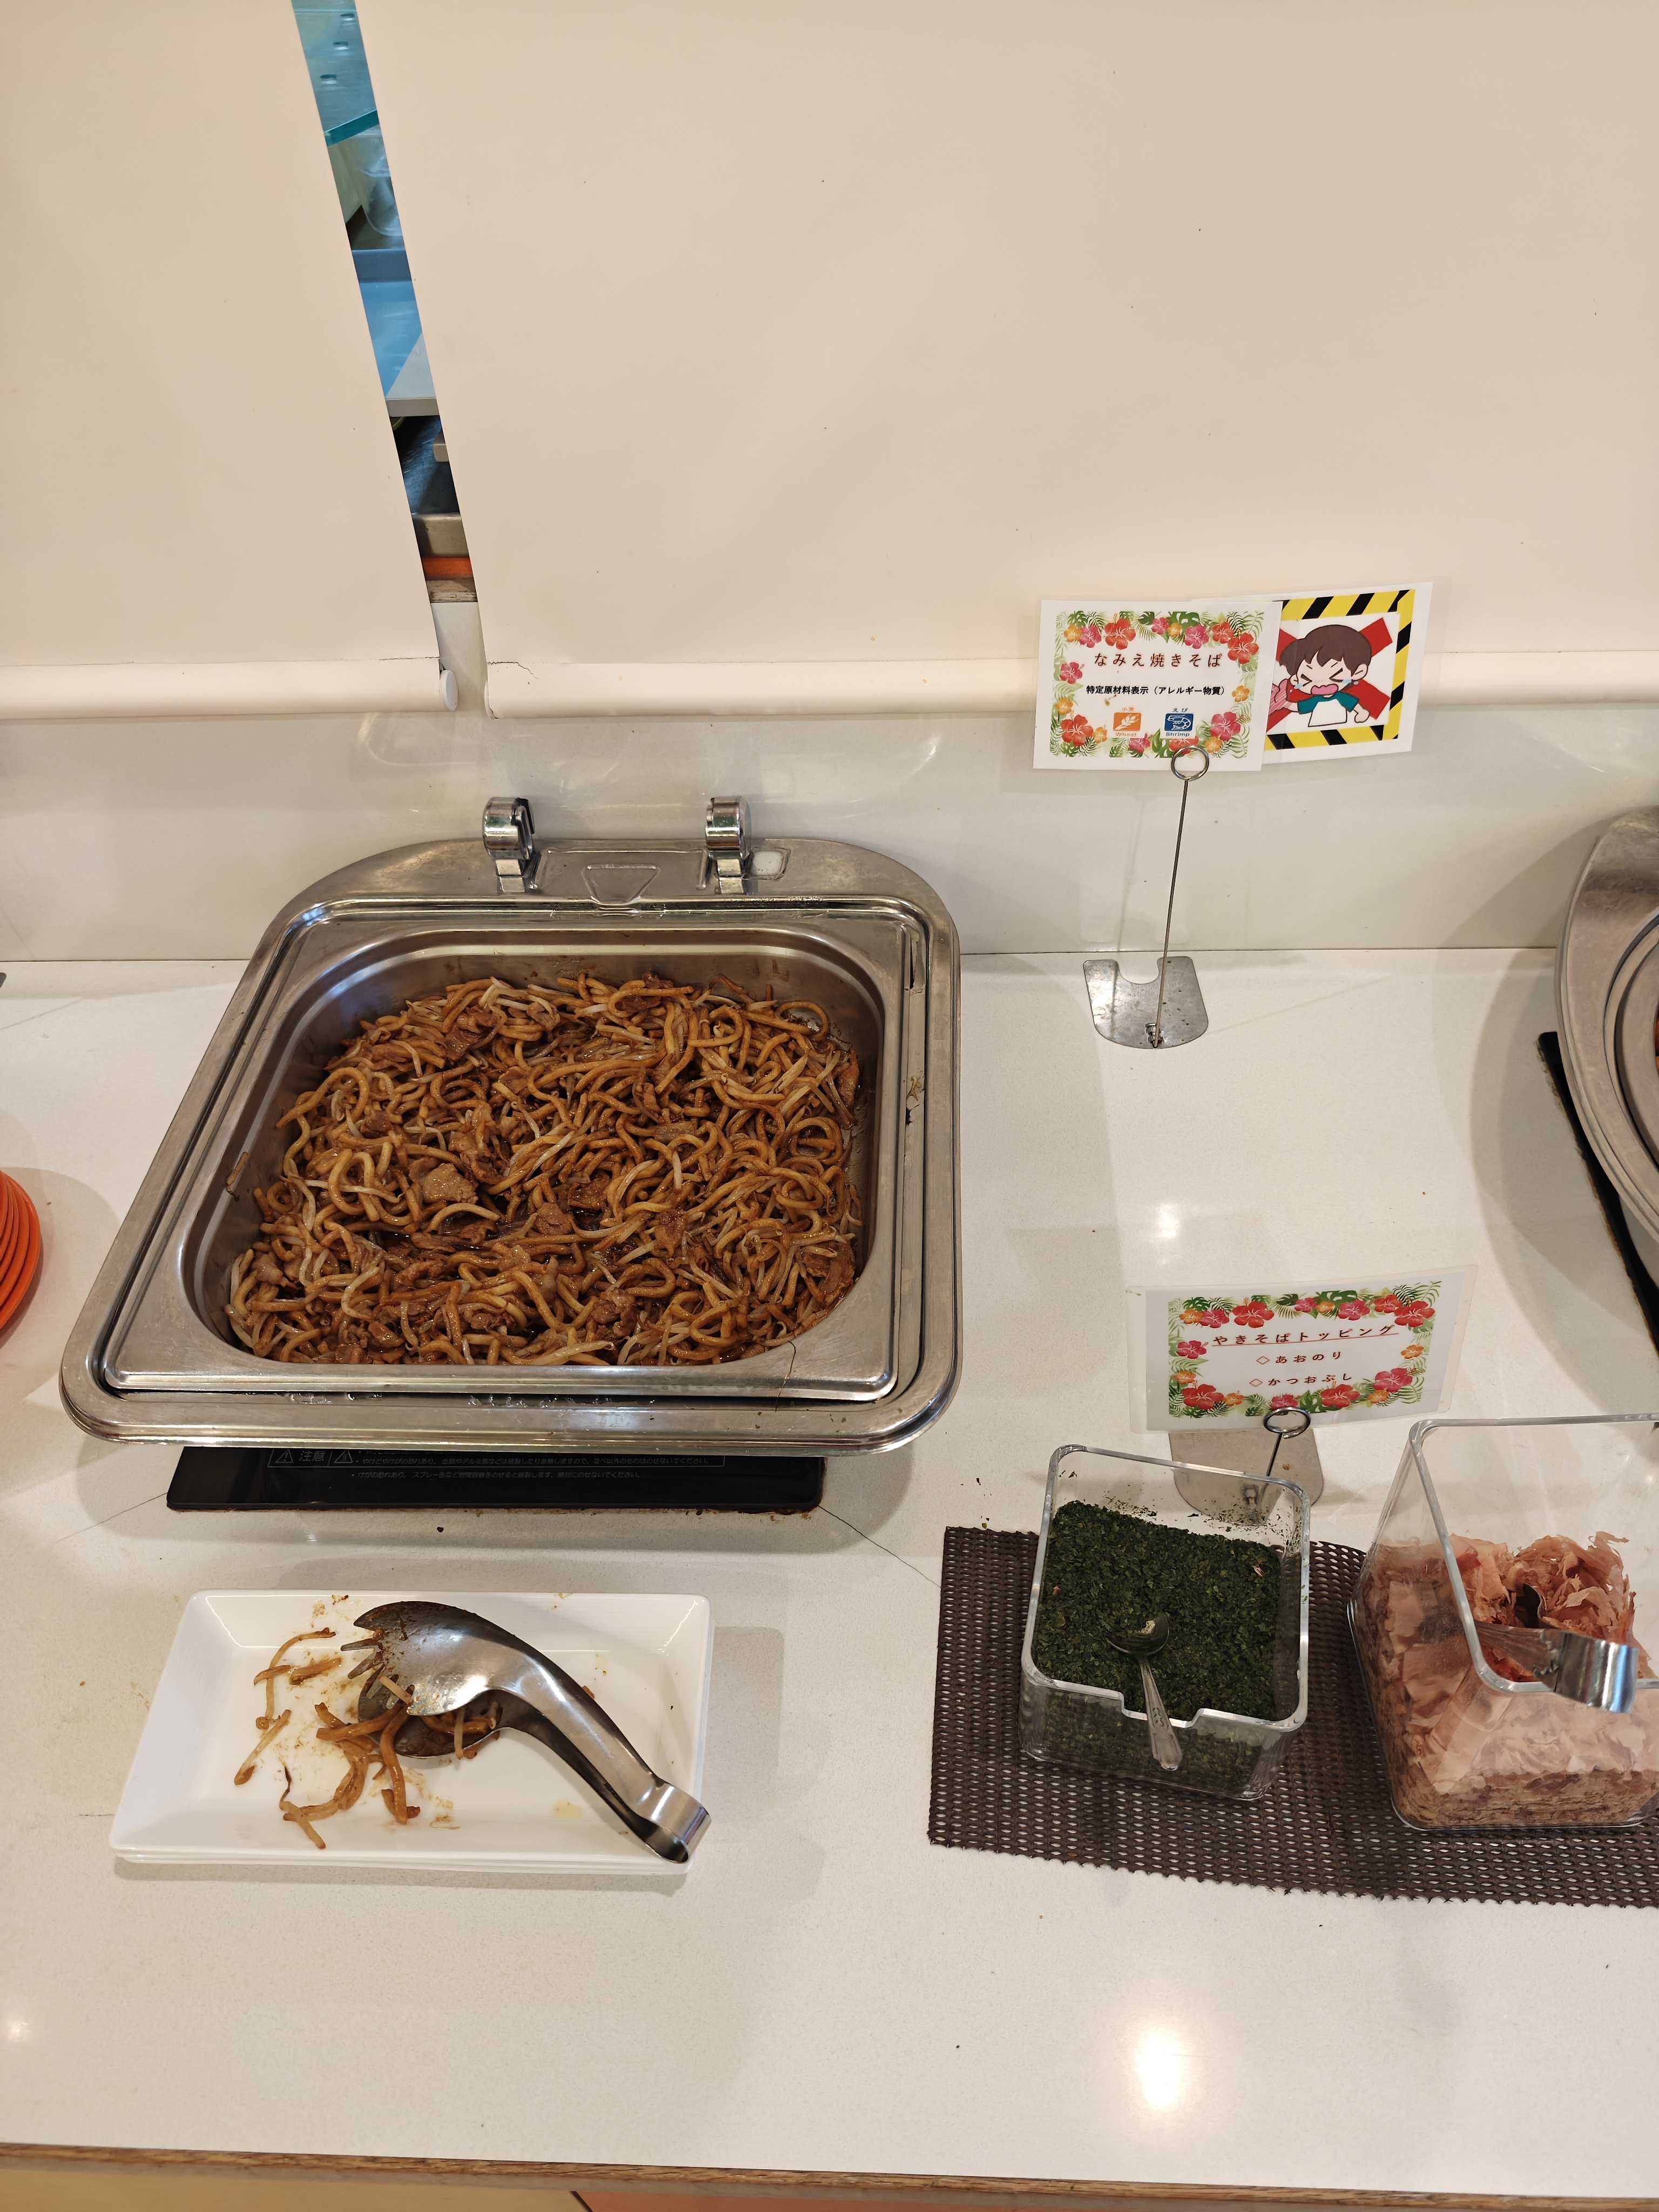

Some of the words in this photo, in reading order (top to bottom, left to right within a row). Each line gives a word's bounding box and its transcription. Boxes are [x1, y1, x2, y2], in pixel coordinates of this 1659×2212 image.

[1094, 652, 1223, 667] なみえ焼きそば
[1086, 685, 1225, 696] 特定原材料表示（アレルギー物質）
[1212, 1324, 1396, 1345] やきそばトッピング
[1275, 1352, 1341, 1364] あおのり
[1268, 1372, 1352, 1386] かつおぶし
[298, 1451, 326, 1461] 注意
